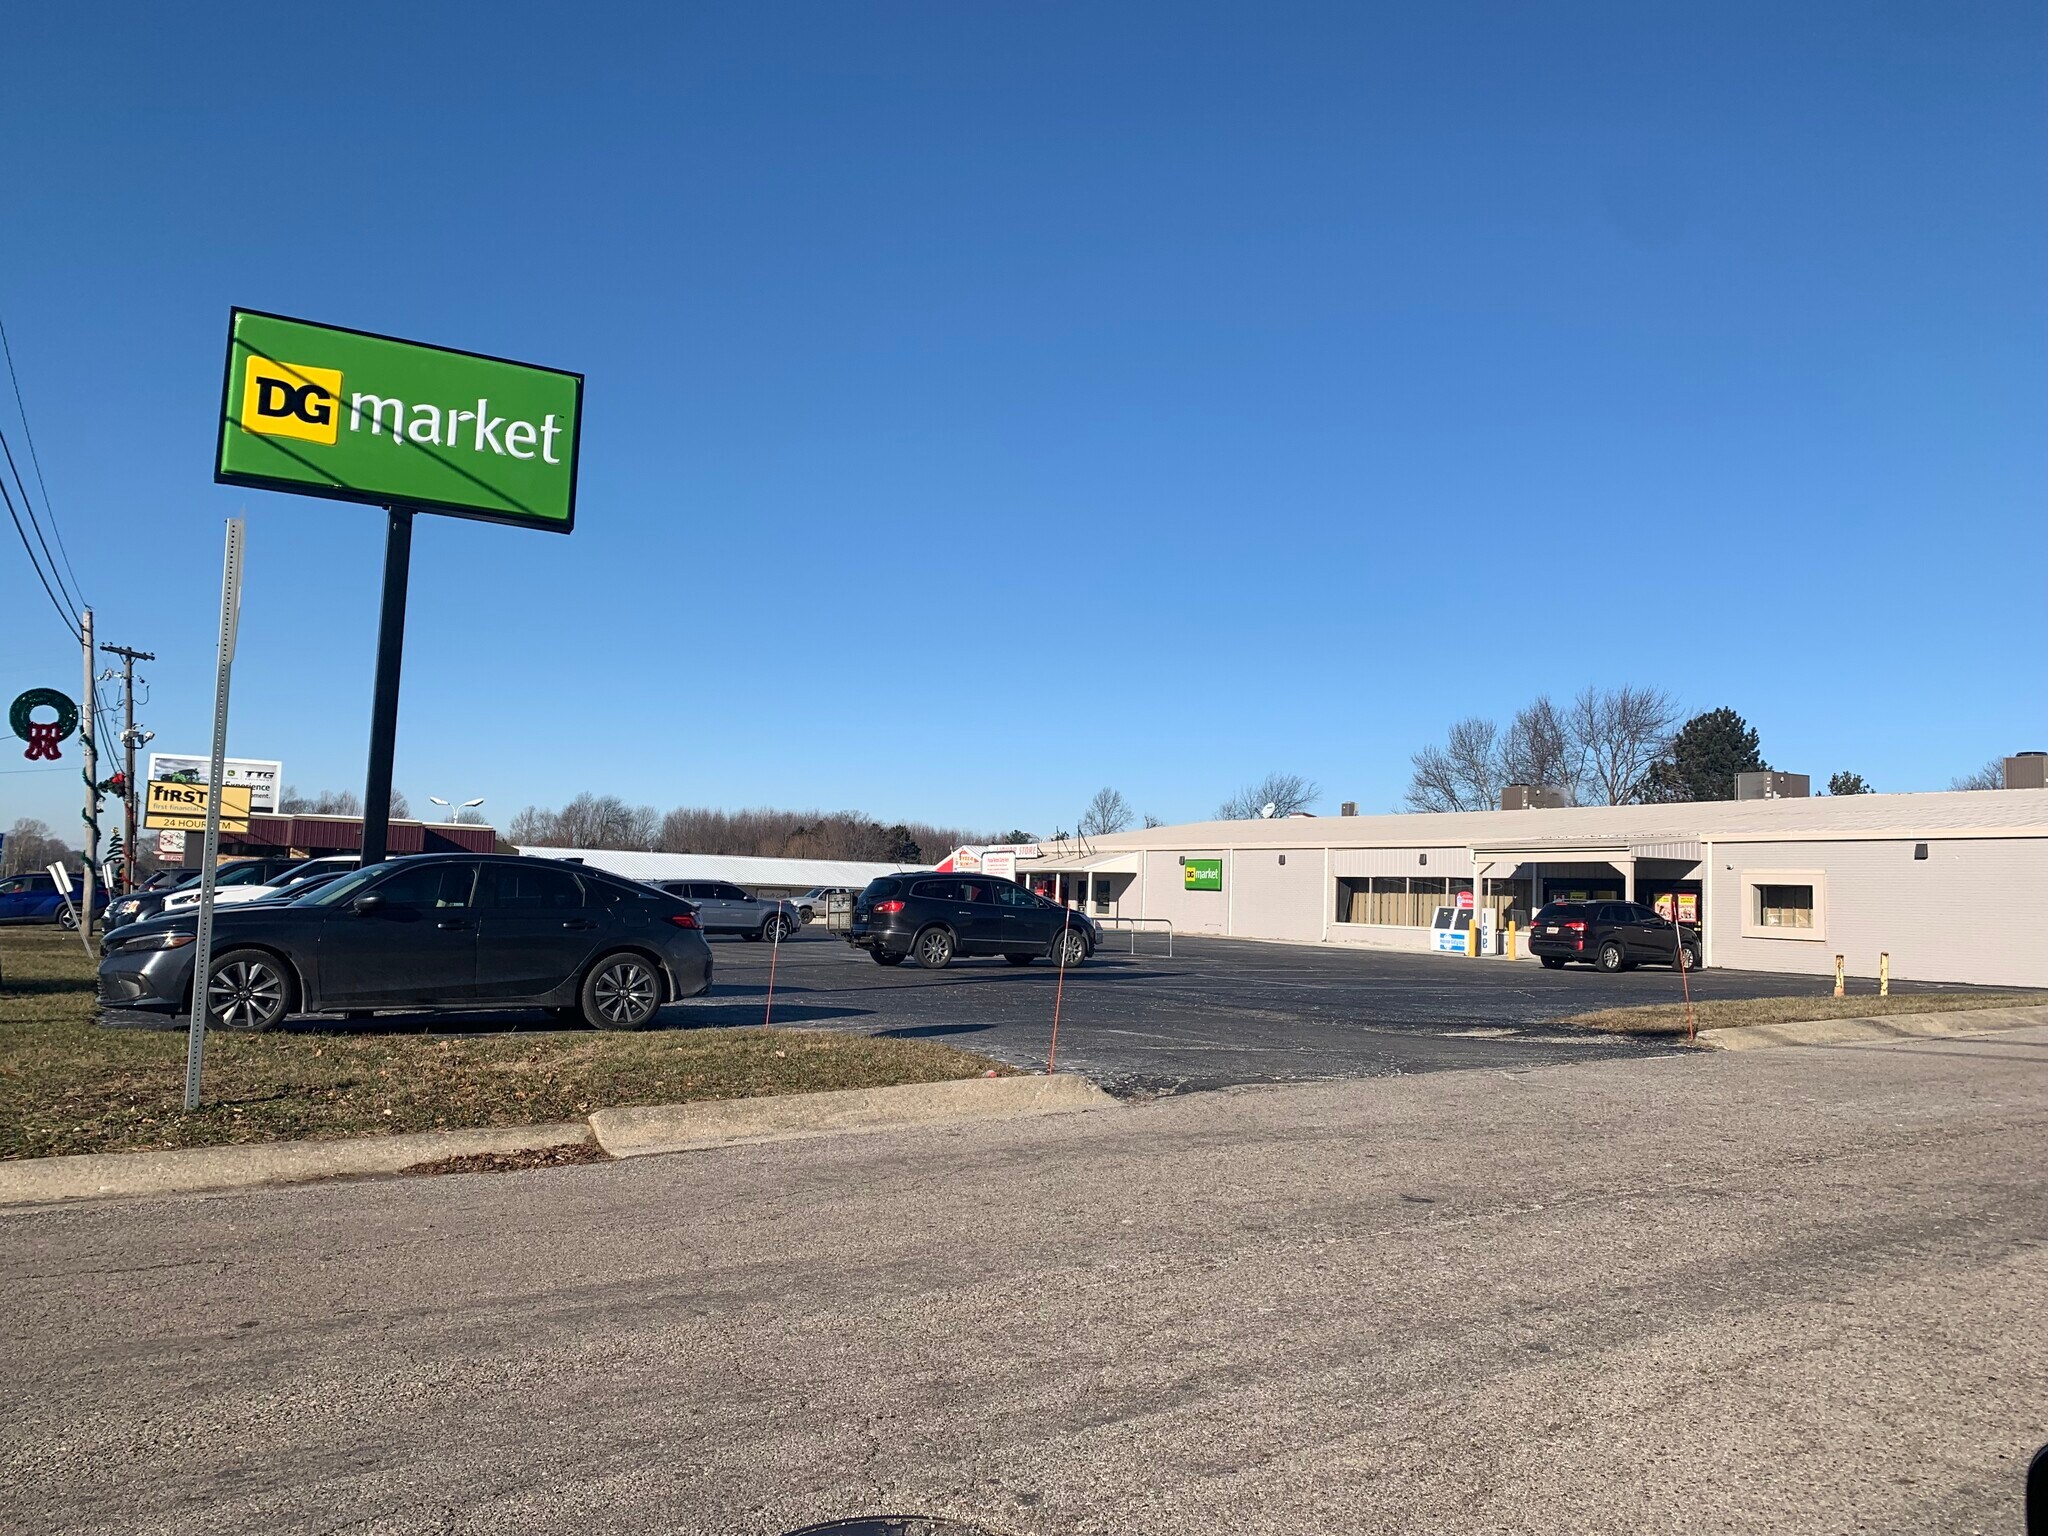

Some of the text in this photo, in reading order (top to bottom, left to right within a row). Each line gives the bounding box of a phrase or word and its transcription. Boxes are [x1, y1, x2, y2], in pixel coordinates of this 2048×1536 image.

[255, 376, 563, 465] DG market
[245, 771, 274, 779] TTG
[169, 804, 199, 812] financial
[163, 818, 176, 827] 24
[1195, 868, 1219, 880] market
